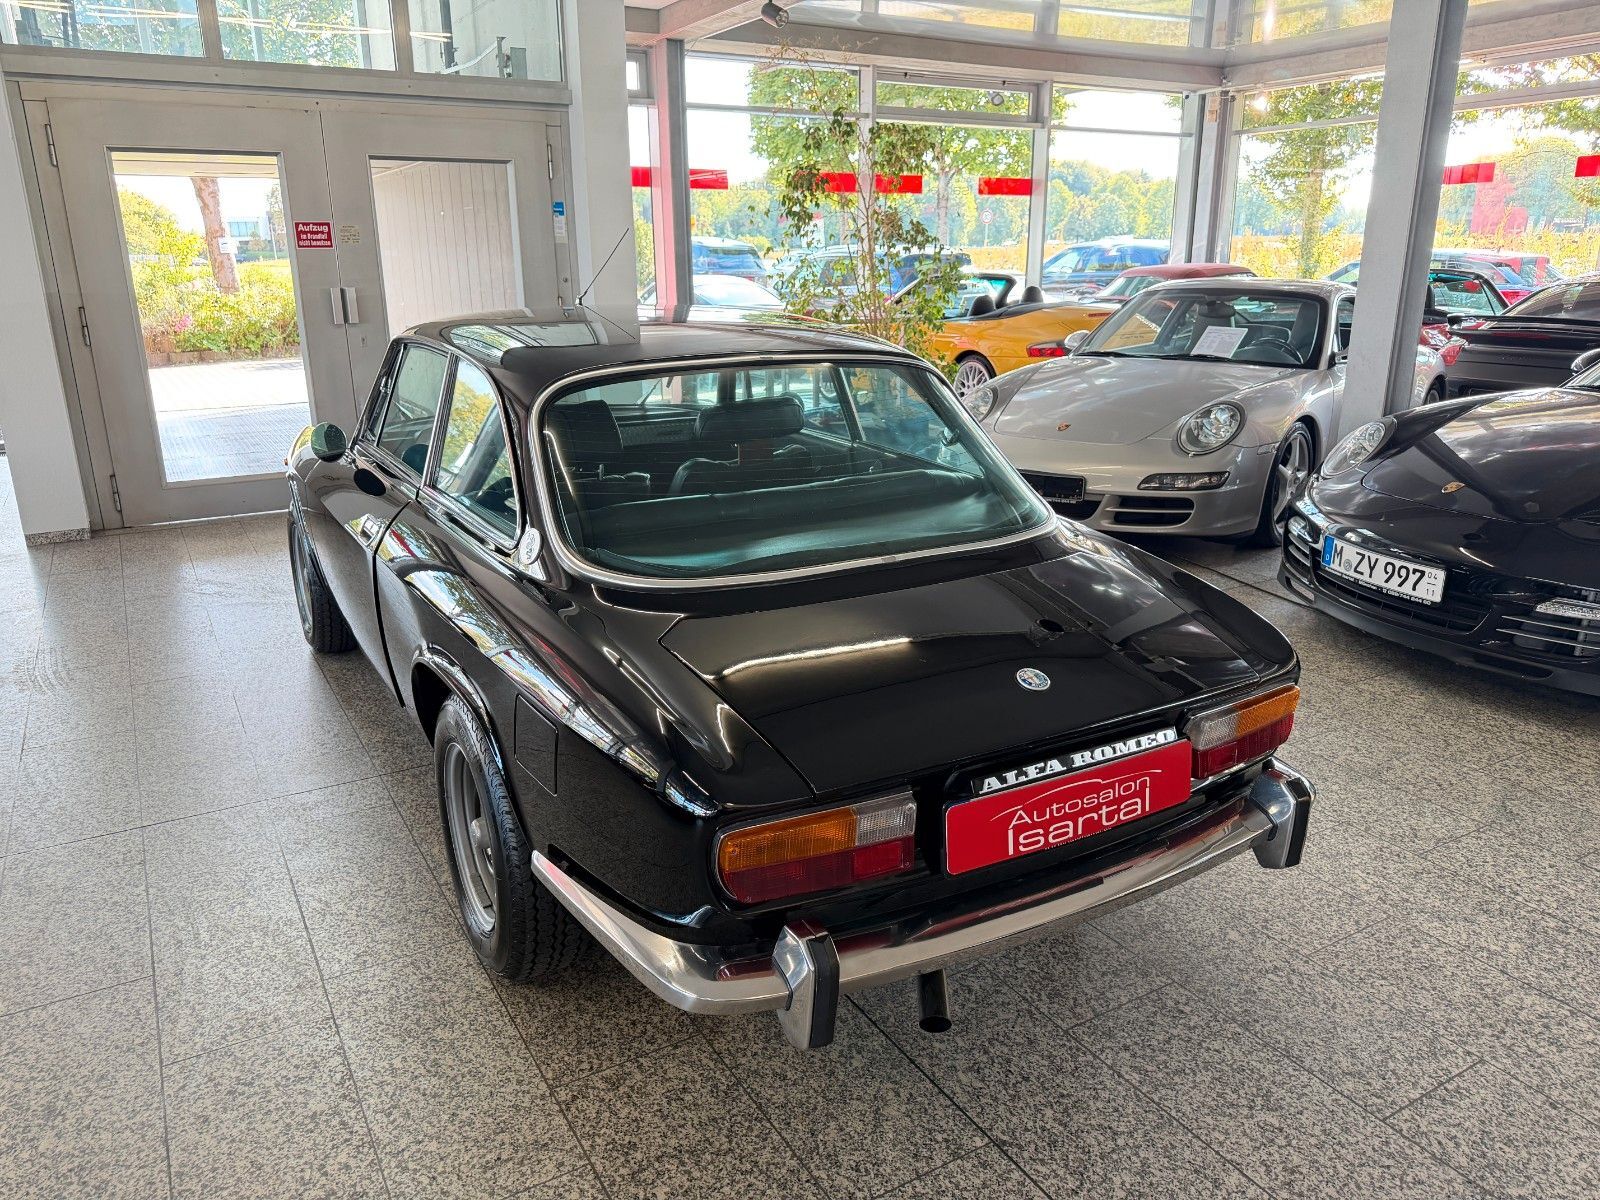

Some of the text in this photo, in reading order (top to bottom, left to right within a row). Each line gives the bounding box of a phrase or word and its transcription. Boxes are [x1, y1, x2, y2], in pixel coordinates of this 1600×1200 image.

[298, 224, 329, 232] Aufzug
[1332, 543, 1427, 592] M ZY 997
[1427, 571, 1438, 580] 04
[1426, 588, 1436, 597] 11
[979, 729, 1176, 795] ALFA ROMEO
[1007, 787, 1150, 856] Isartal
[1008, 776, 1150, 830] Autosalon
